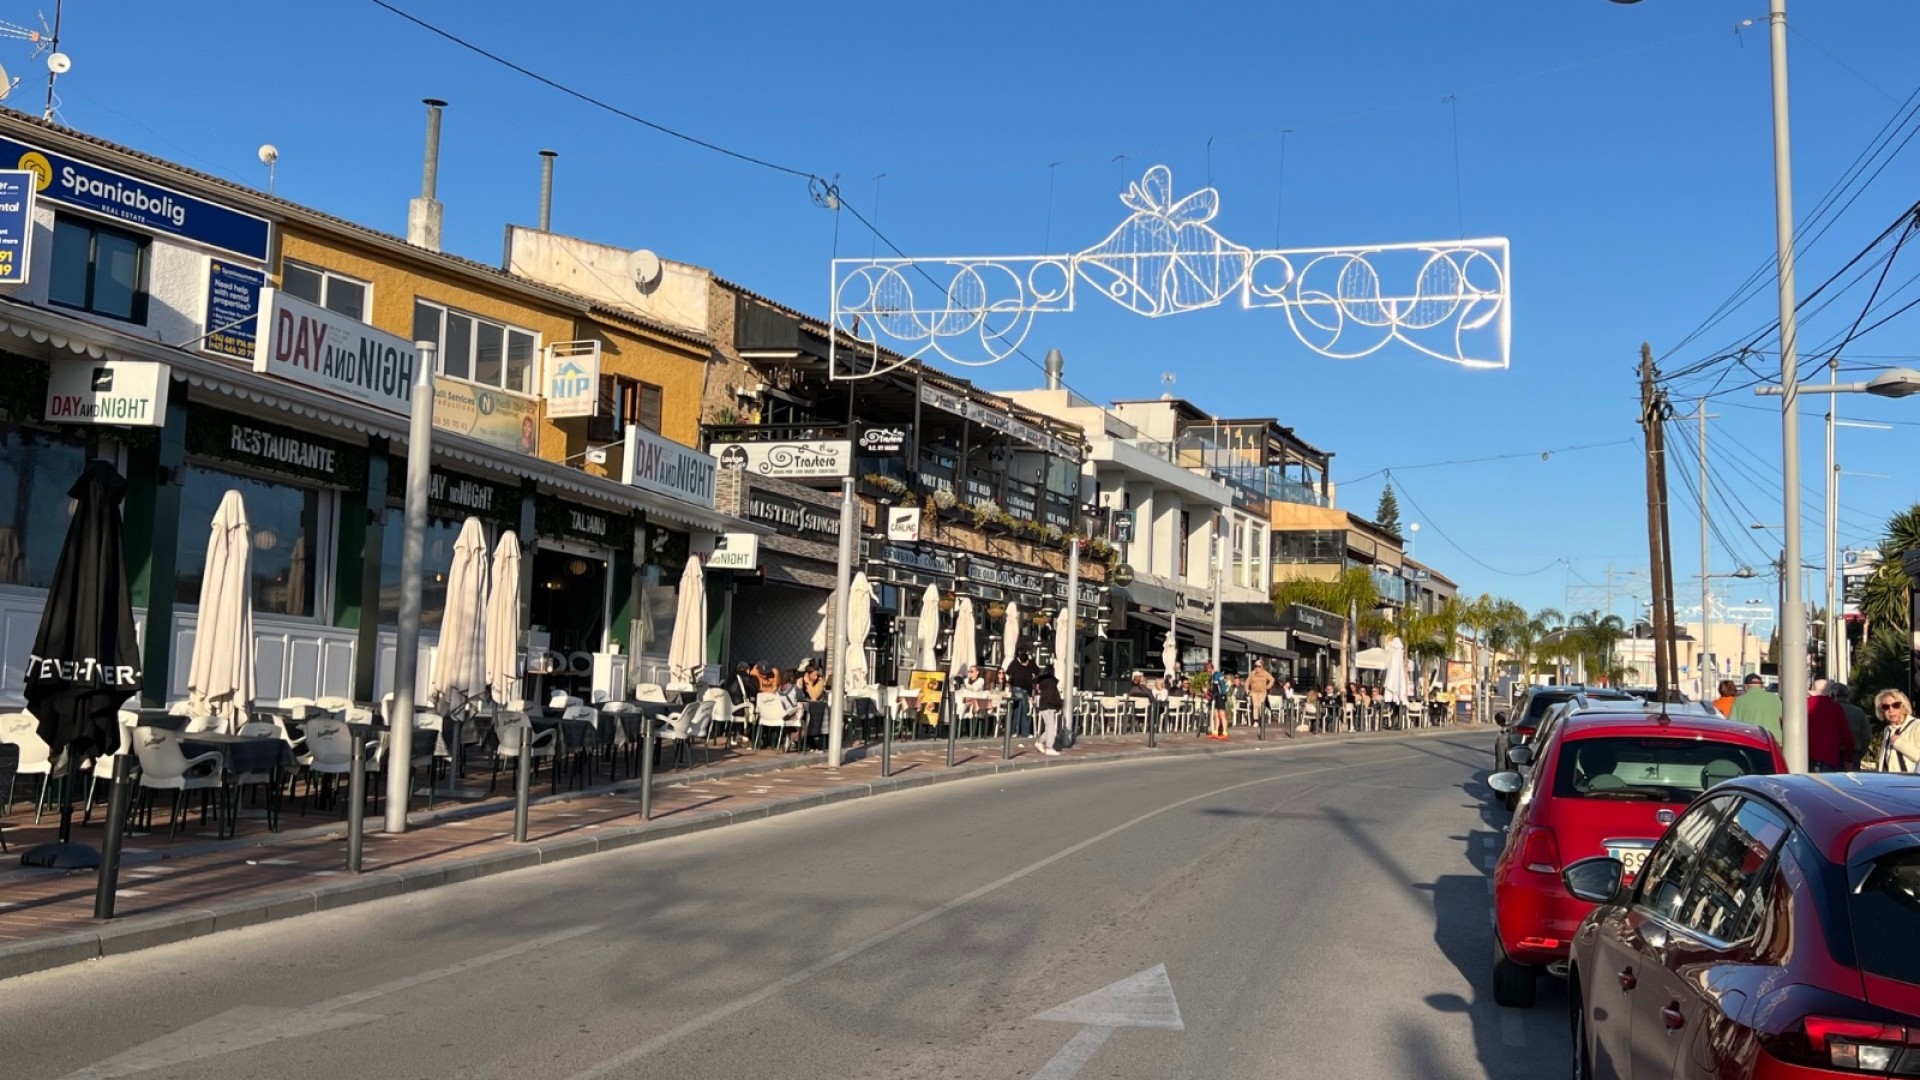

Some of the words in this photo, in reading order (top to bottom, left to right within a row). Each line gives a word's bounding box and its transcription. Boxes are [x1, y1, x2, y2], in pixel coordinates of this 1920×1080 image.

[61, 166, 186, 226] Spaniabolig
[101, 204, 119, 216] REAL
[120, 209, 146, 223] ESTATE
[214, 279, 232, 290] Need
[233, 282, 249, 295] help
[214, 288, 229, 298] with
[213, 296, 252, 312] properties?
[276, 308, 327, 372] DAY
[323, 345, 356, 384] AND
[358, 337, 414, 401] NIGH
[551, 377, 590, 399] NIP
[51, 395, 82, 416] DAY
[101, 397, 150, 419] NIGHT
[231, 424, 336, 473] RESTAURANTE
[635, 439, 662, 482] DAY
[659, 461, 677, 488] AND
[676, 453, 714, 499] NIGHT
[794, 455, 836, 468] Trastero
[749, 500, 799, 526] MISTER
[890, 523, 916, 532] CARLING
[720, 552, 750, 565] NIGHT
